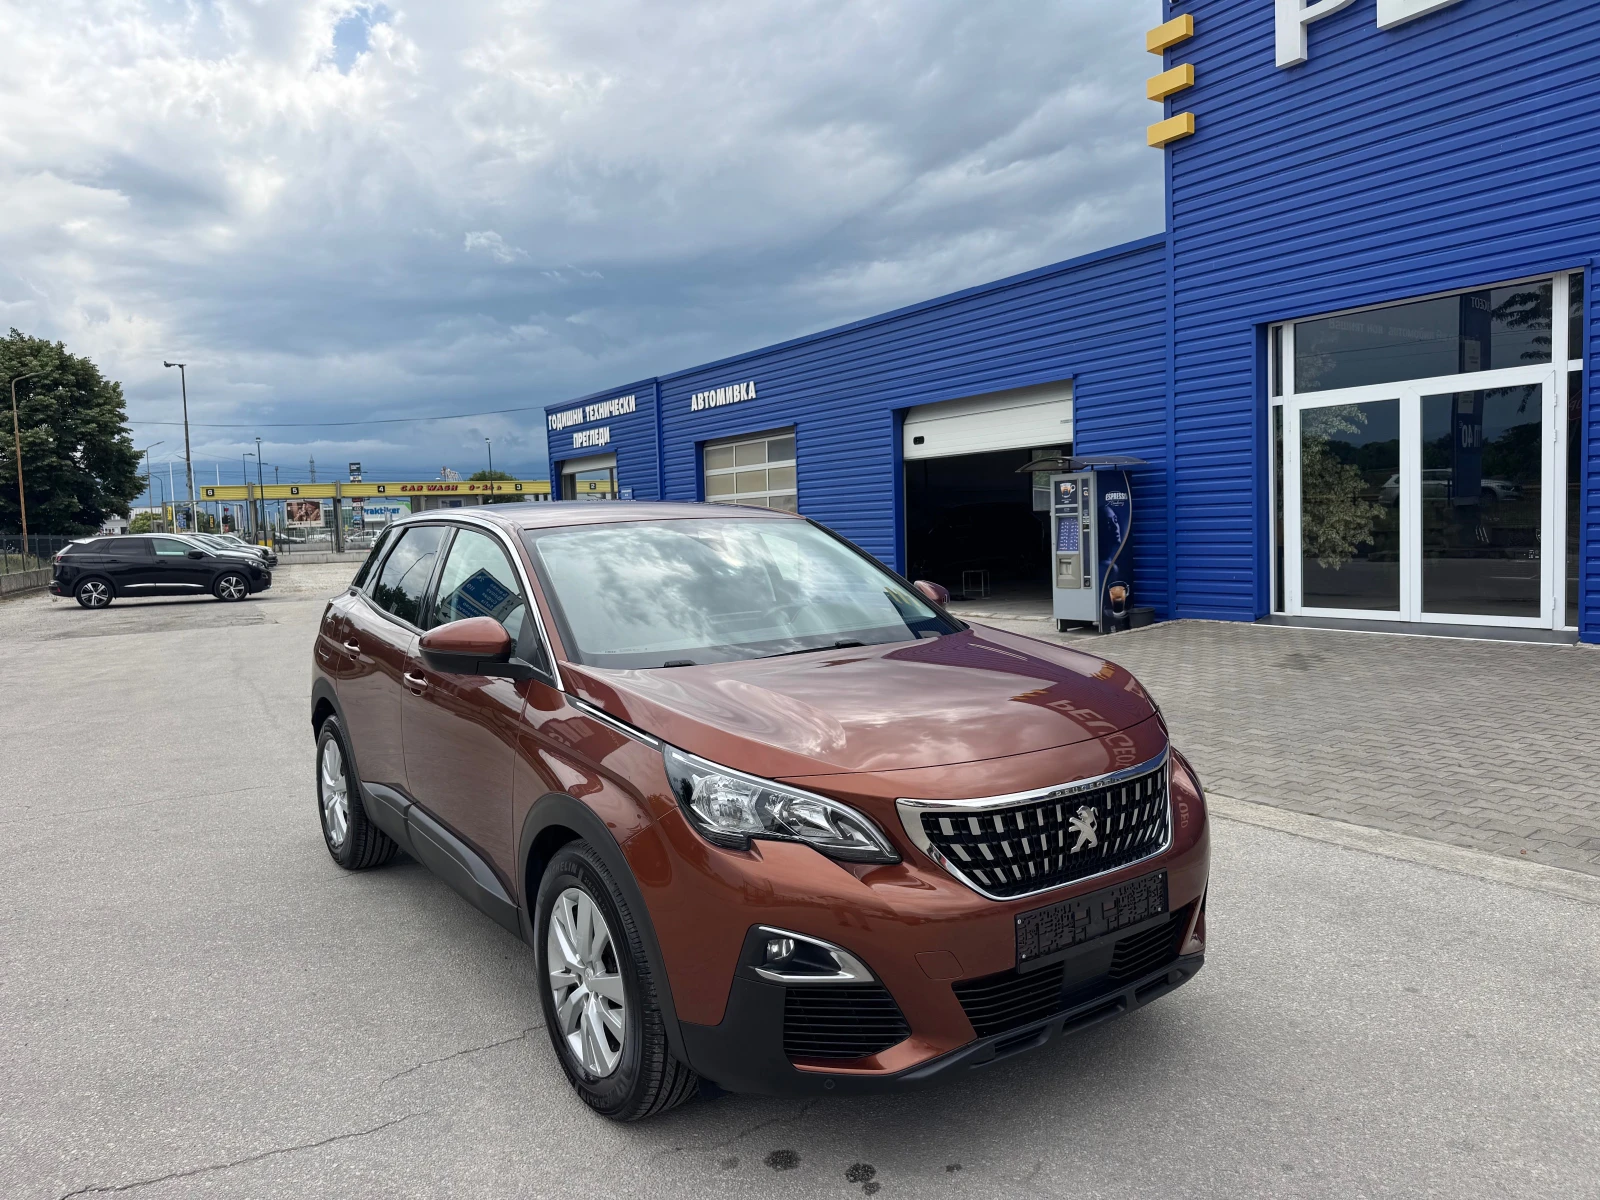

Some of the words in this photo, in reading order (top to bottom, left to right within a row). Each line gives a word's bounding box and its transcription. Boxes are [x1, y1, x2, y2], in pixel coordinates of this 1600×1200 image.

[690, 380, 757, 412] АВТОМИВКА
[548, 408, 584, 431] ГОДИШНИ
[585, 394, 636, 423] ТЕХНИЧЕСКИ
[572, 426, 611, 449] ПРЕГЛЕДИ
